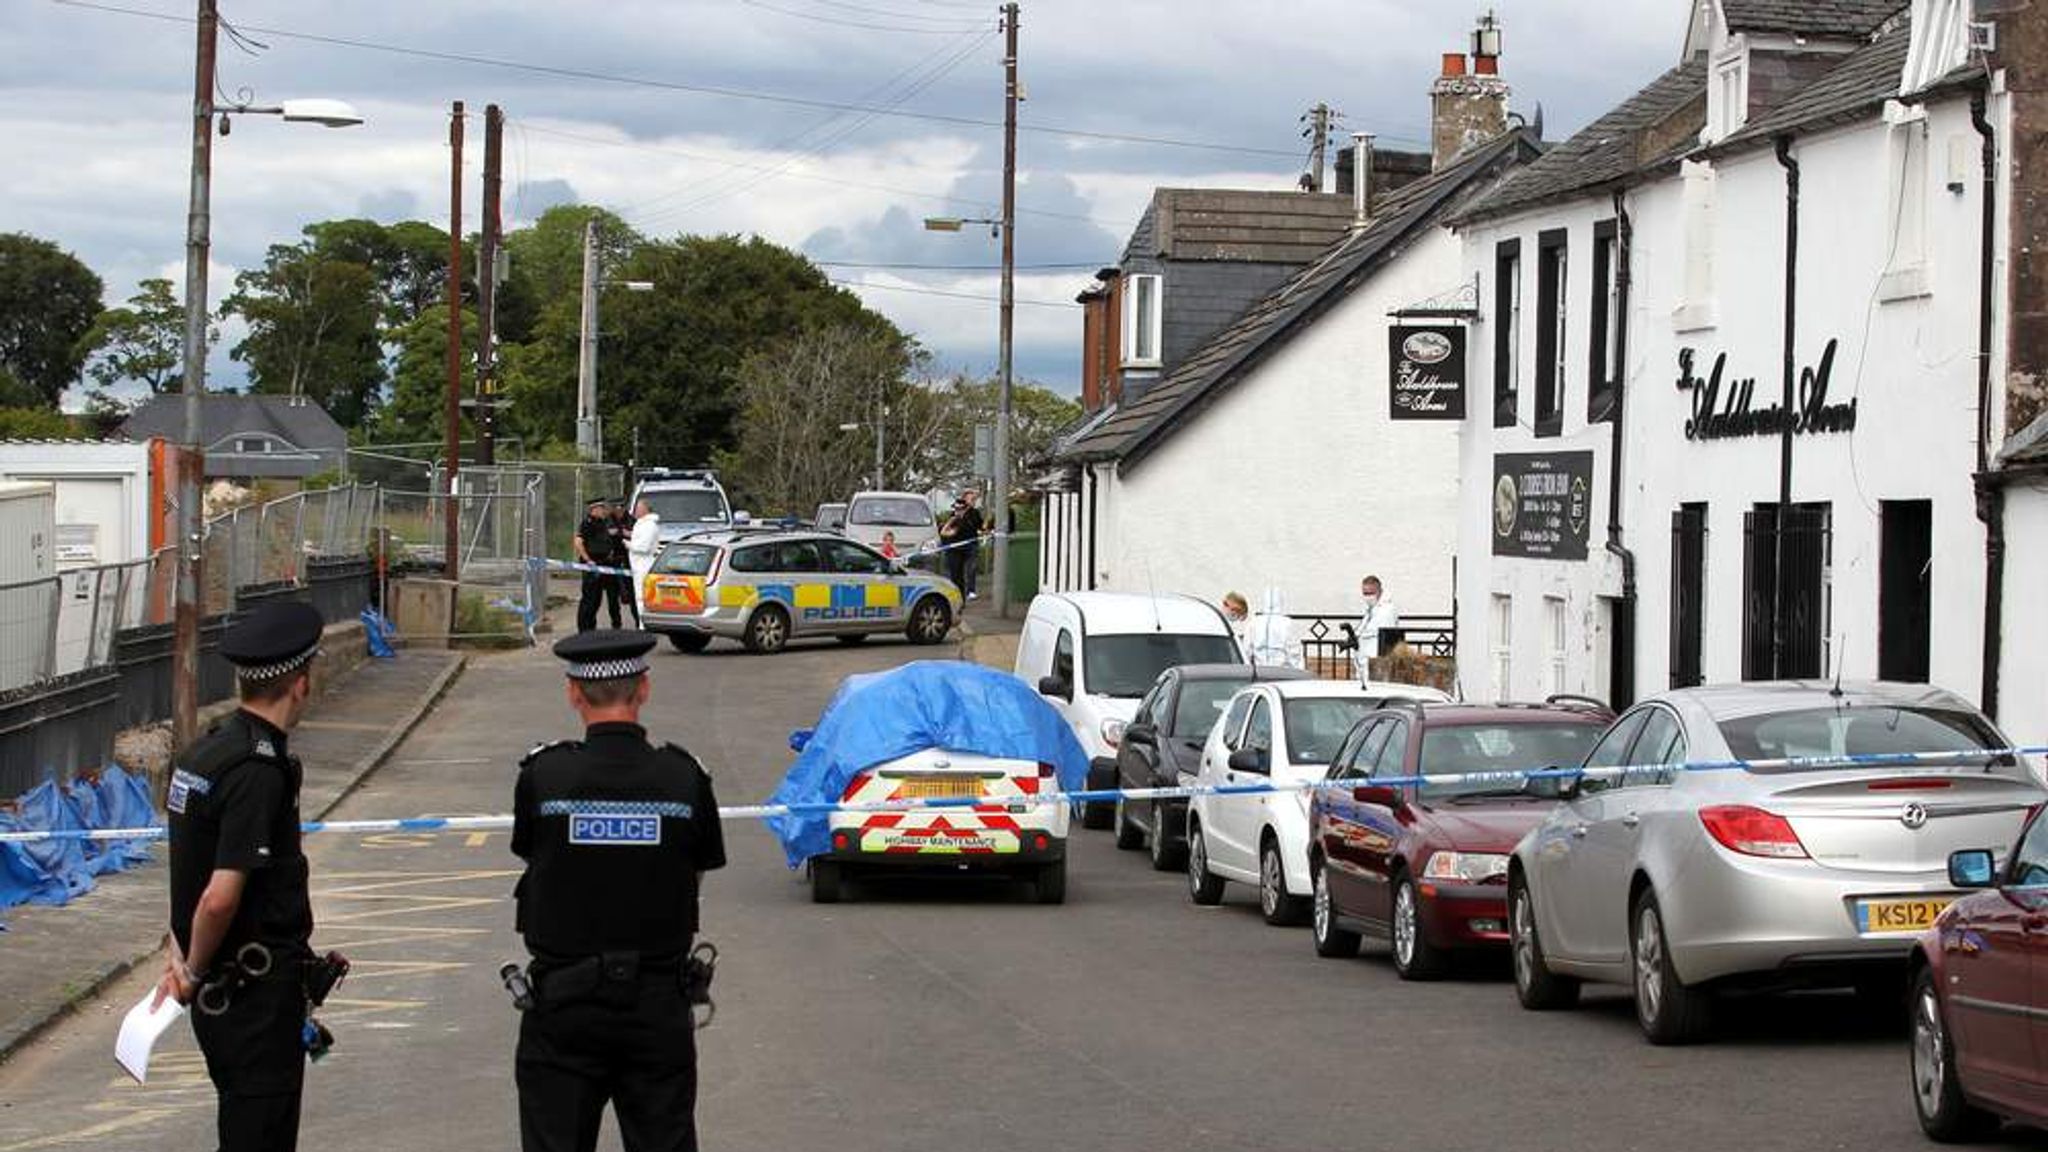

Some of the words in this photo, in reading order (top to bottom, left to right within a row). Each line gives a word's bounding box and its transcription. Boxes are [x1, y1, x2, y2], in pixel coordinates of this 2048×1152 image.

[803, 606, 892, 620] POLICE
[574, 819, 657, 839] POLICE
[884, 836, 928, 846] HIGHWAY
[929, 837, 998, 848] MAINTENANCE
[1877, 902, 1929, 927] KS12
